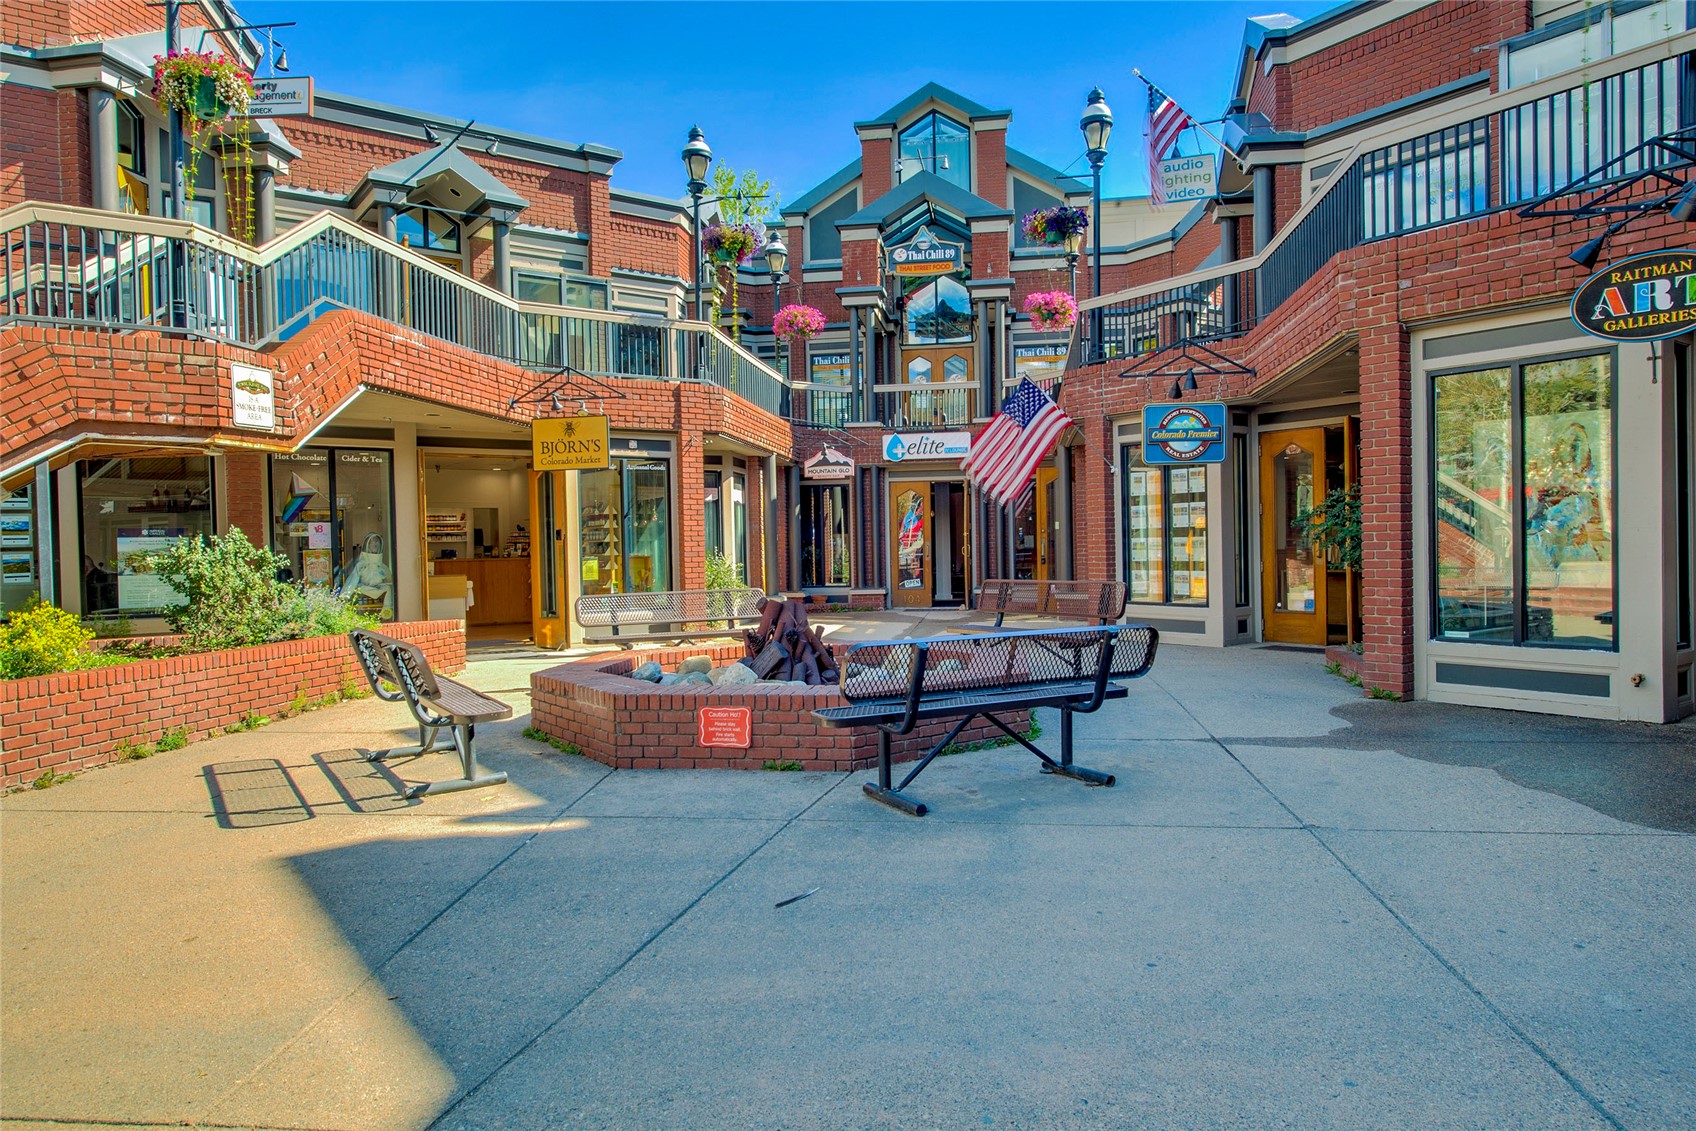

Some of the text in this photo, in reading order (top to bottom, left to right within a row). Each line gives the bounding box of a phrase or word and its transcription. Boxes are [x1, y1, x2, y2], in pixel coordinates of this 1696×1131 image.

[1164, 159, 1203, 173] audio
[1161, 172, 1211, 189] ighting
[1165, 187, 1205, 199] video
[907, 248, 955, 260] Thai Chili 89
[899, 263, 951, 272] THAI STREET FOOD
[1611, 259, 1693, 284] RAITMAN
[1590, 272, 1696, 320] ART
[1603, 308, 1696, 332] GALLERIES
[1017, 346, 1067, 357] Thai Chili 89
[813, 356, 831, 365] Thai
[832, 355, 850, 364] Chili
[1162, 408, 1207, 425] RESORT PROPERTIES
[1151, 428, 1219, 439] Colorado Premier
[540, 438, 601, 458] BJÖRN'S
[906, 435, 945, 456] elite
[1165, 445, 1205, 458] REAL ESTATE
[274, 452, 327, 461] Hot Chocolate
[341, 454, 360, 462] Cider
[370, 455, 383, 463] Tea
[540, 455, 601, 466] Colorado Market
[905, 579, 920, 587] OPEN
[903, 594, 921, 604] 104
